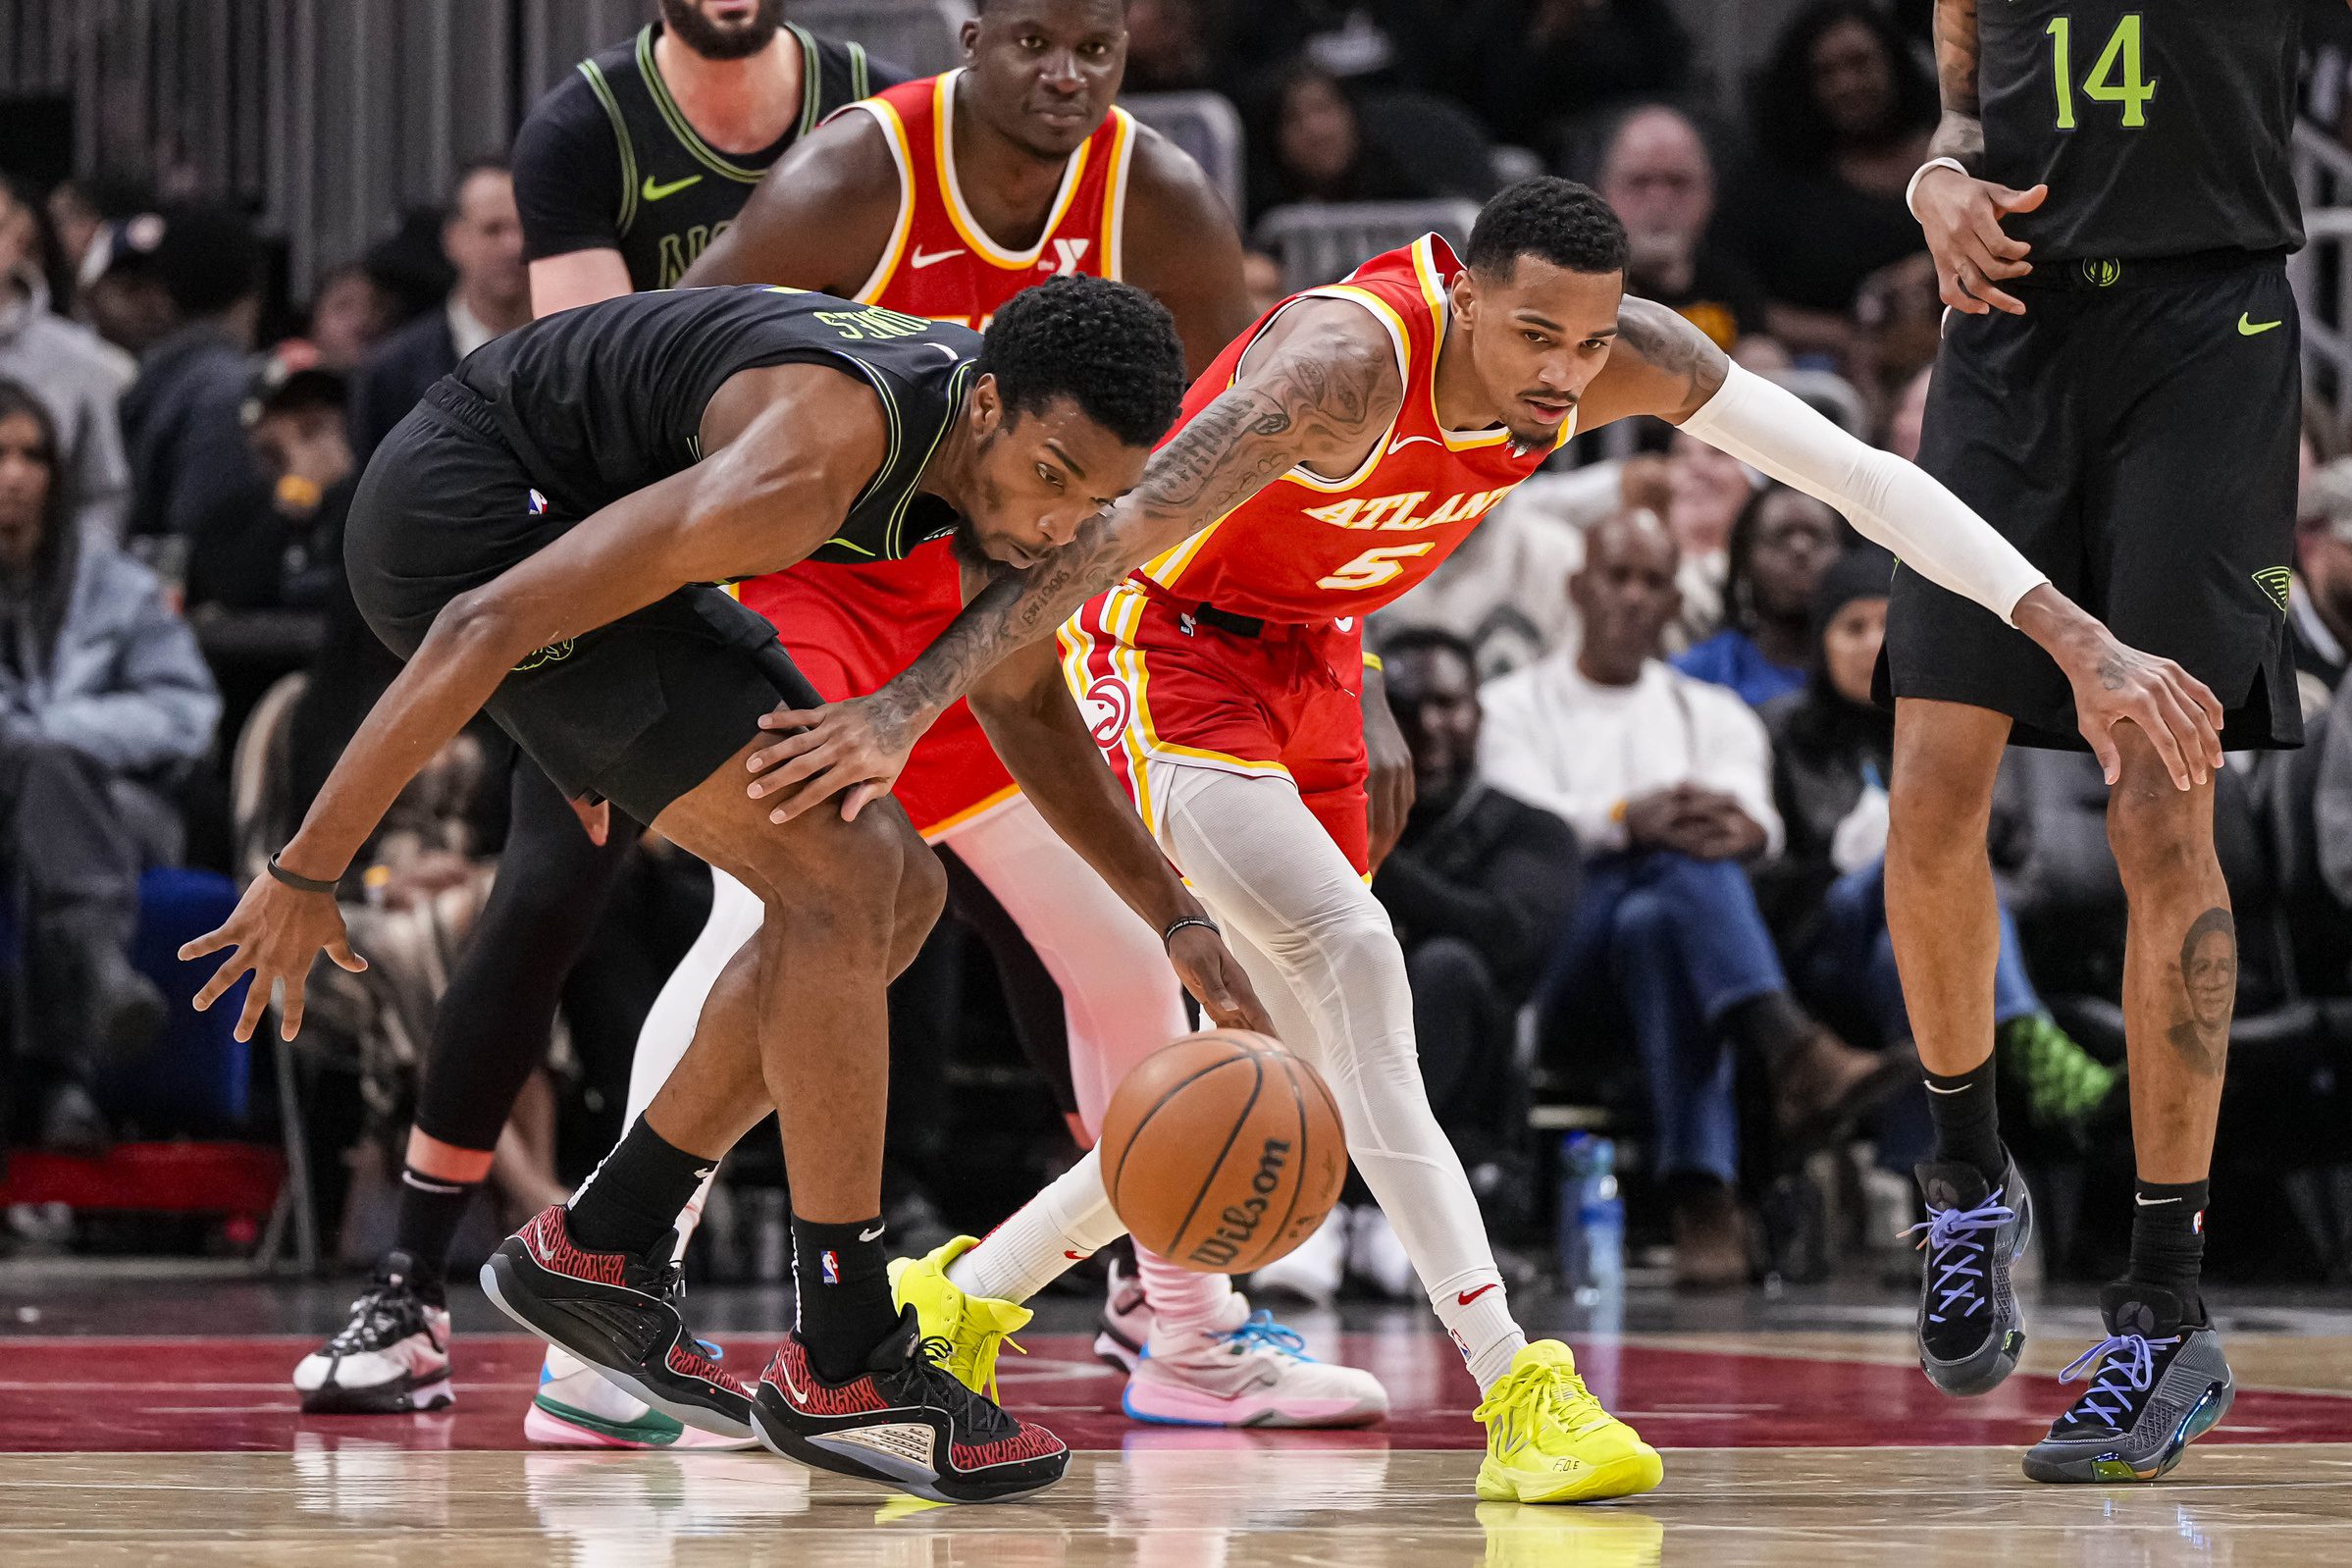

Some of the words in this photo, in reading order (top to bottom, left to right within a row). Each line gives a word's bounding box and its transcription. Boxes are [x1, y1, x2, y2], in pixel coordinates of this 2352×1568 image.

[2046, 15, 2157, 129] 14
[1315, 542, 1436, 591] 5
[1188, 1138, 1291, 1266] Wilson
